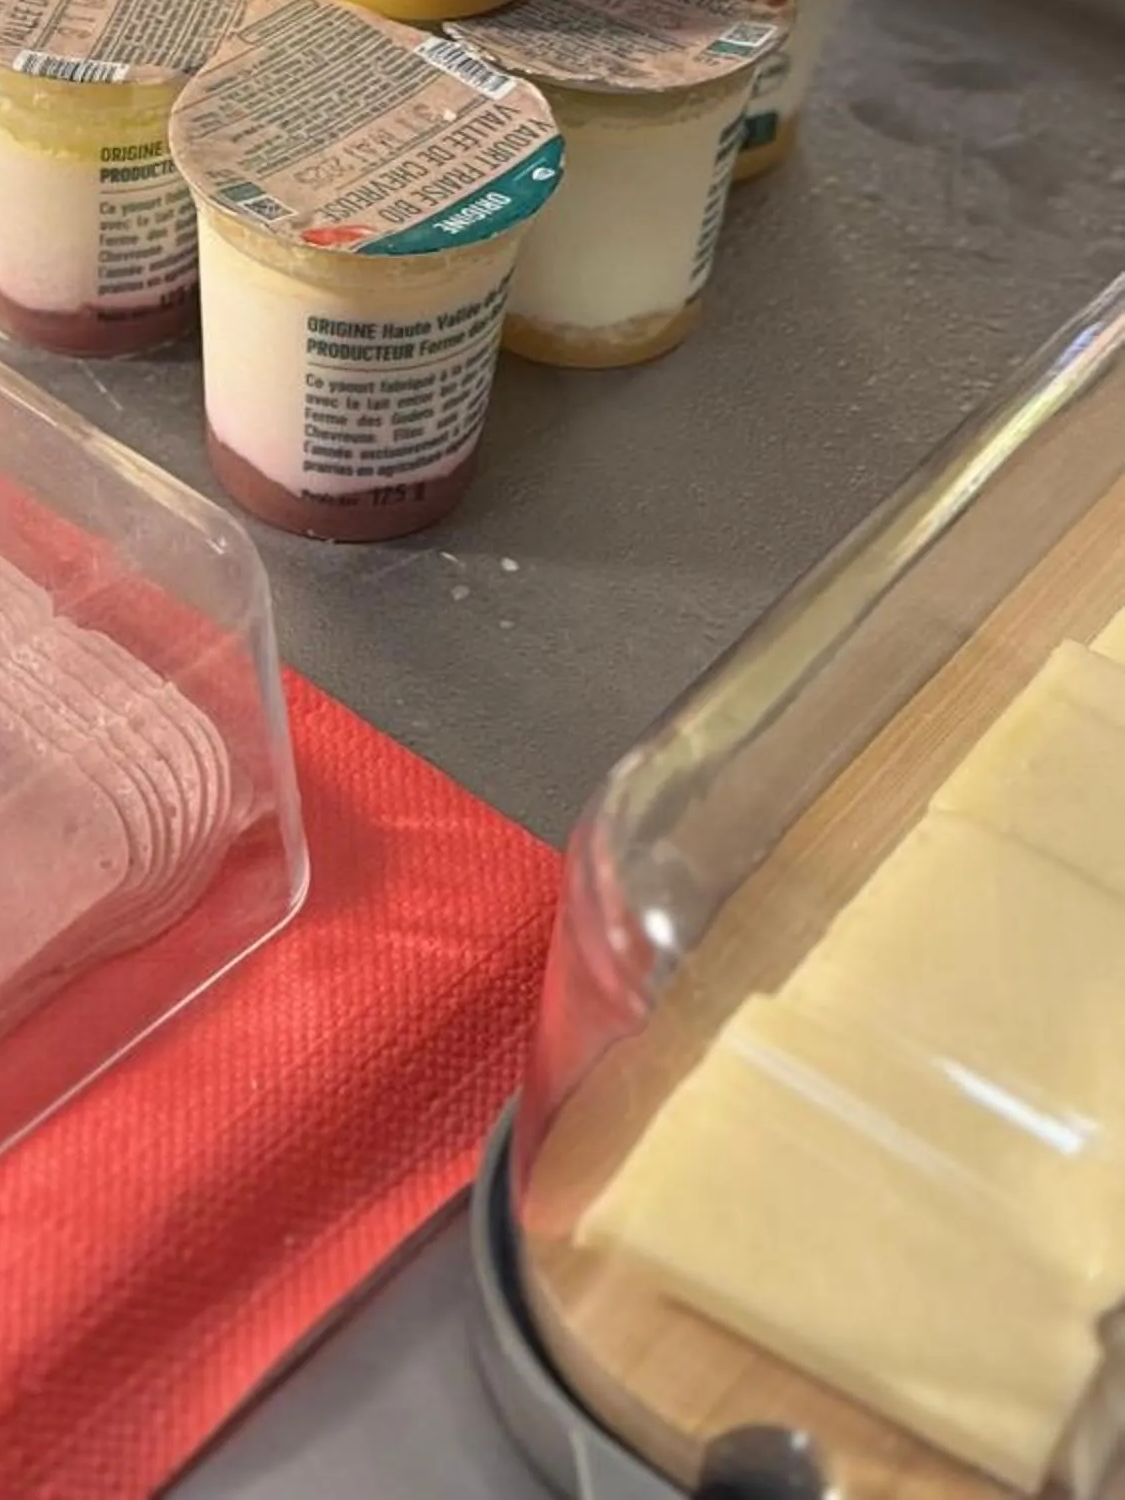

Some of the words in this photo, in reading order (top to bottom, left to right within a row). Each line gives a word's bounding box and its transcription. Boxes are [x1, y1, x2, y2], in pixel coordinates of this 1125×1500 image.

[441, 103, 522, 151] VALLÉE
[100, 140, 163, 163] ORIGINE
[426, 145, 456, 168] DE
[478, 118, 555, 171] YAOURT
[99, 159, 178, 184] PRODUCTE
[416, 160, 485, 207] FRAISE
[315, 150, 430, 224] CHEVREUSE
[378, 198, 423, 224] BIO
[432, 191, 512, 235] ORIGINE
[307, 315, 377, 339] ORIGINE
[382, 321, 432, 339] Haute
[306, 338, 415, 362] PRODUCTEUR
[419, 333, 466, 357] Ferme
[306, 373, 324, 389] Ce
